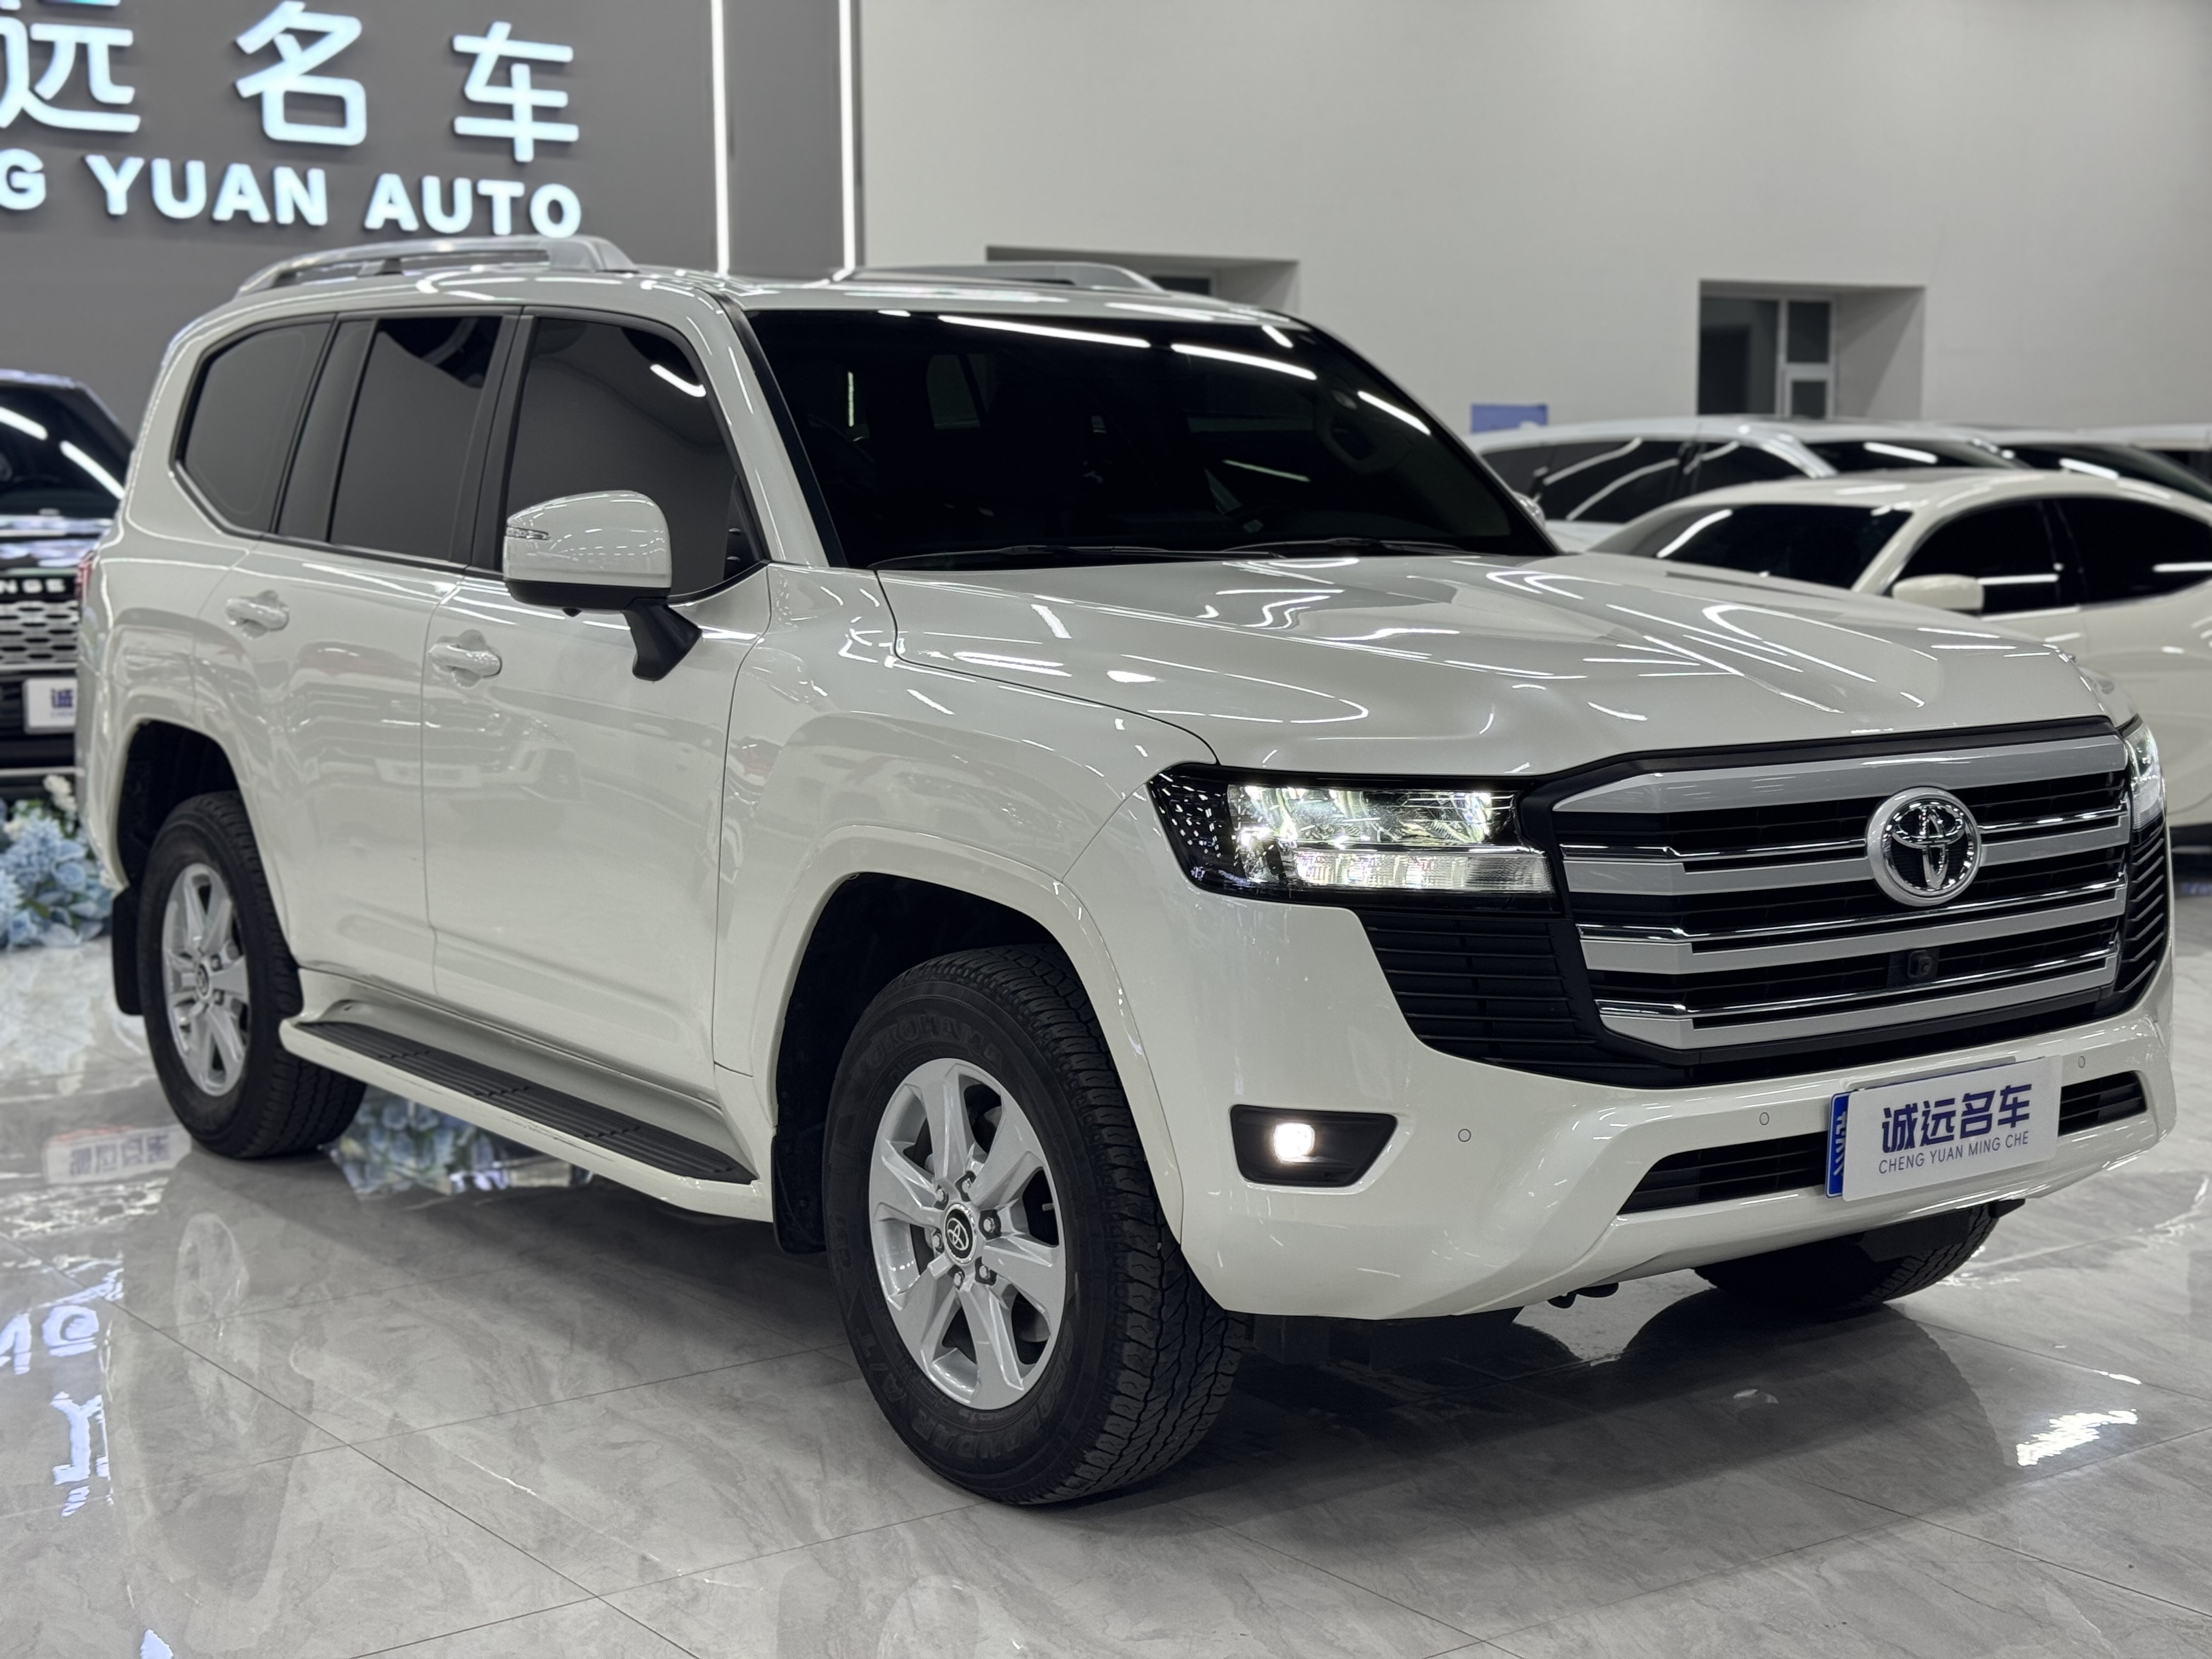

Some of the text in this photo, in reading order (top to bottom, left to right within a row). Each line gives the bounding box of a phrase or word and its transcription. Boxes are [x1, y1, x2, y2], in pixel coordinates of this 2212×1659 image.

[0, 0, 580, 163] 远名车
[86, 154, 329, 226] YUAN
[364, 173, 583, 239] AUTO
[1879, 1130, 2029, 1175] CHENG YUAN MING CHE
[1881, 1084, 2033, 1154] 诚远名车
